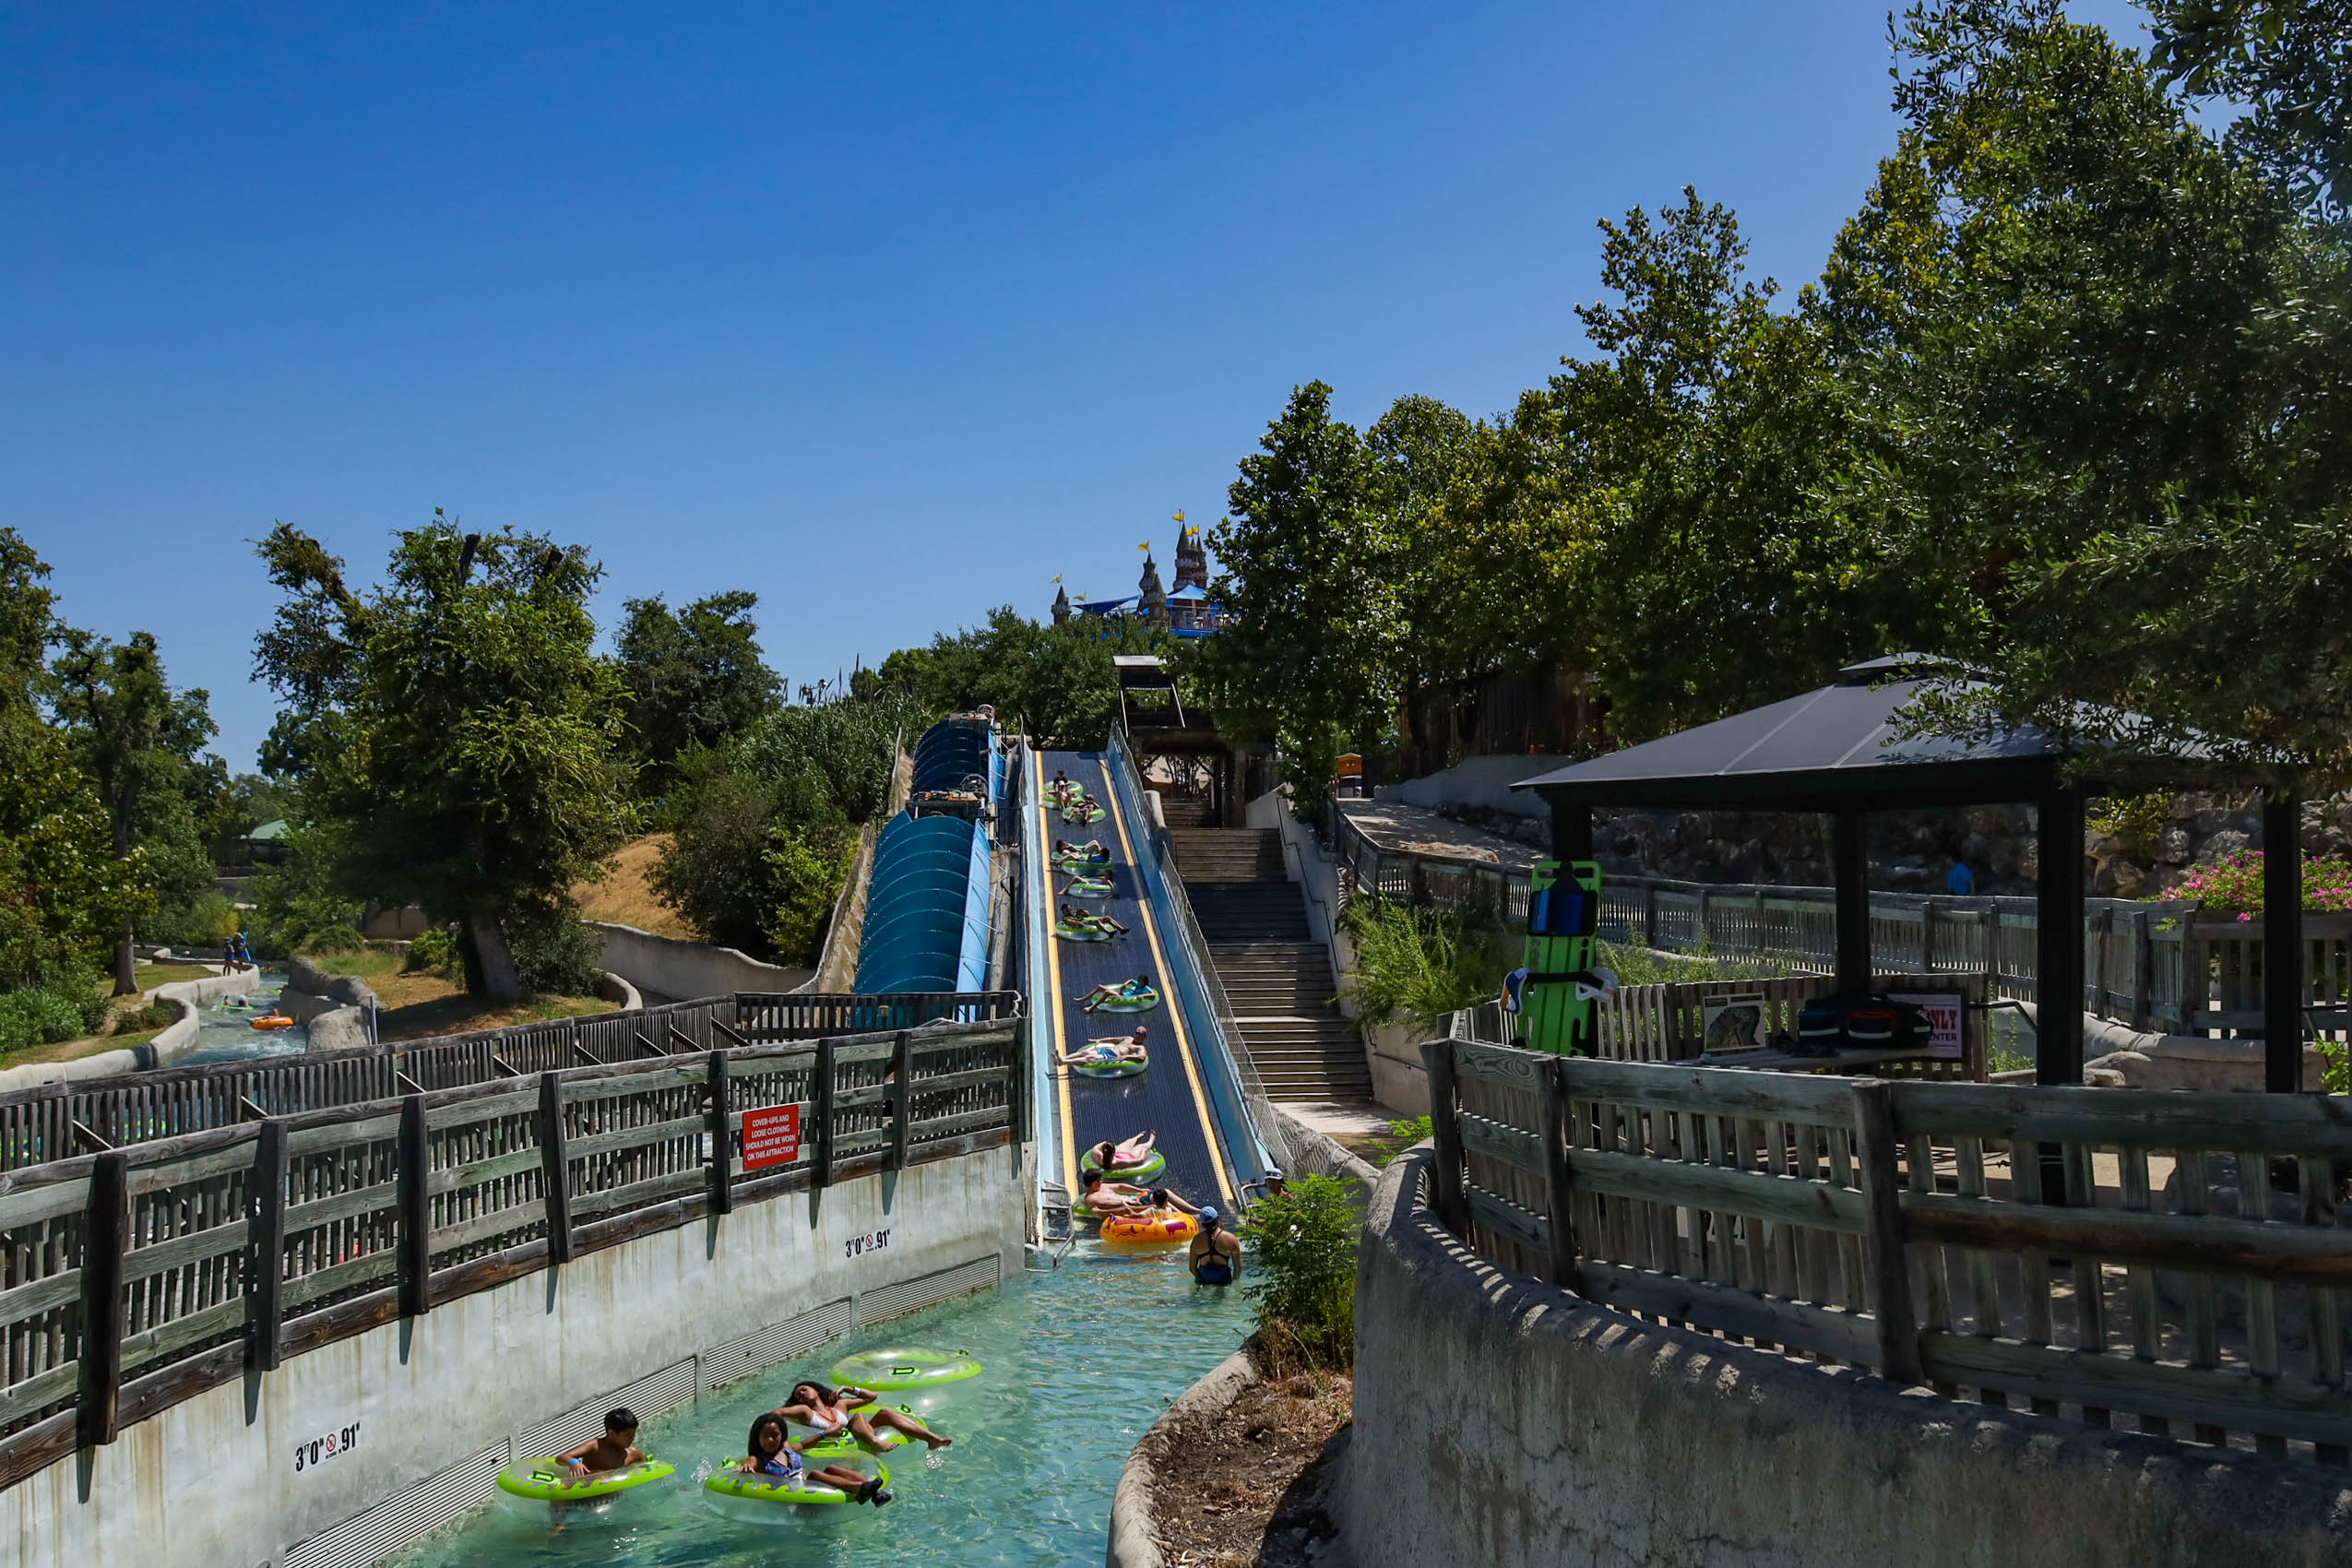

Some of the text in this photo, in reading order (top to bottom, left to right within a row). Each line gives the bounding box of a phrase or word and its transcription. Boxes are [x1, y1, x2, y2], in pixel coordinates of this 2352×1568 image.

[1929, 1010, 1956, 1029] NLY
[1932, 1033, 1957, 1041] NTER
[753, 1114, 790, 1127] COVER-UPS AND
[752, 1124, 790, 1138] LOOSE CLOTHING
[745, 1142, 764, 1150] SHOULD
[765, 1138, 774, 1146] NOT
[781, 1134, 796, 1143] WORN
[747, 1146, 793, 1161] ON THIS ATTRACTION
